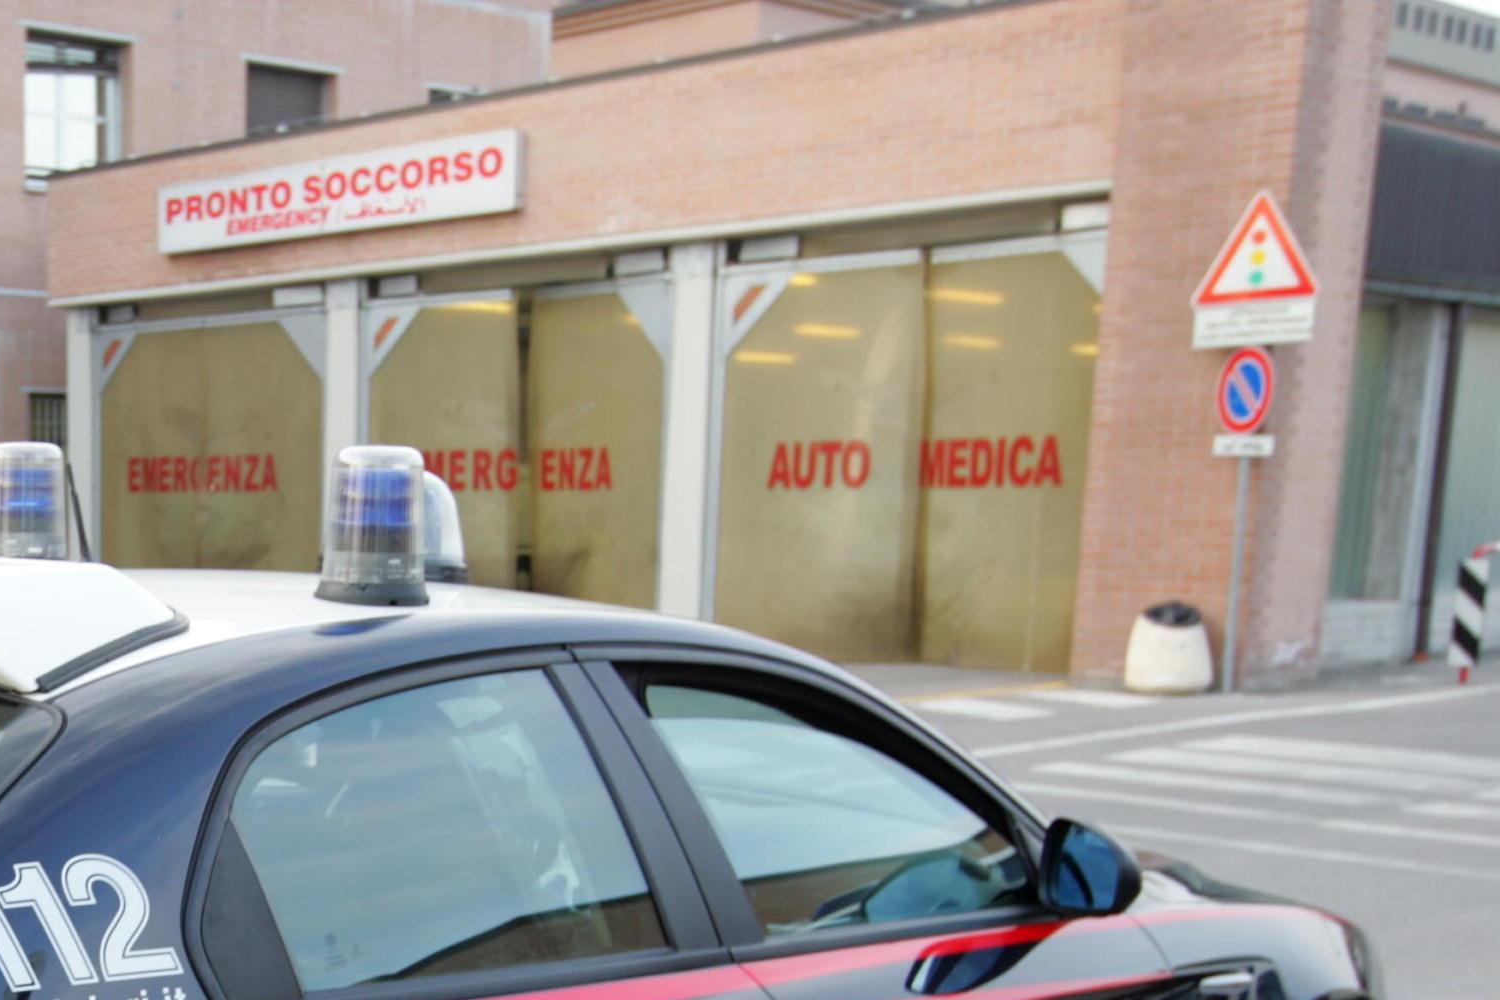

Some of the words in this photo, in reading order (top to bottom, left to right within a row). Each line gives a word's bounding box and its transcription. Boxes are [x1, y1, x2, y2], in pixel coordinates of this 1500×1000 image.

[165, 181, 292, 225] PRONTO
[303, 146, 504, 204] SOCCORSO
[225, 205, 329, 236] EMERGENCY
[766, 440, 872, 490] AUTO
[917, 433, 1064, 489] MEDICA
